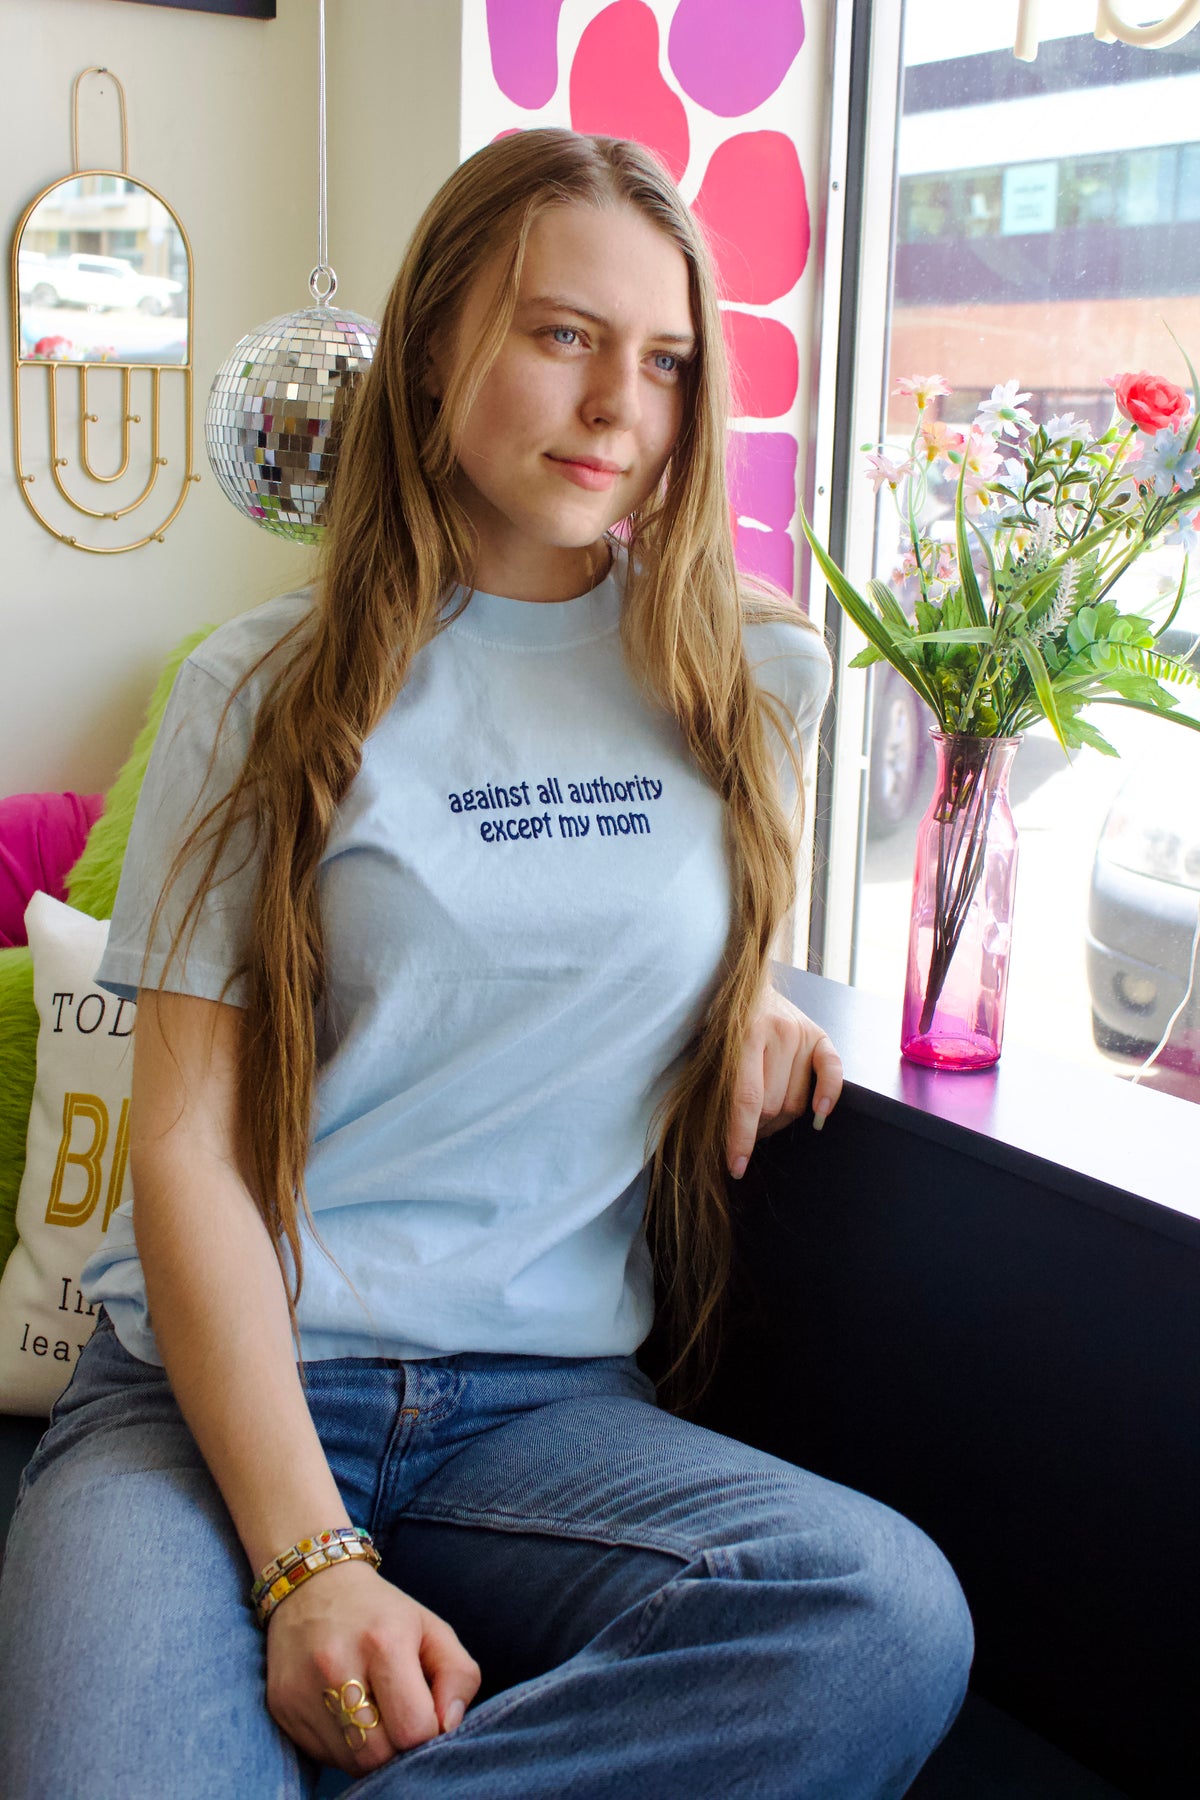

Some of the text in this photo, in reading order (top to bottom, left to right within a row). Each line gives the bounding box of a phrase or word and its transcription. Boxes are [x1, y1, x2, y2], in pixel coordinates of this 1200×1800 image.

[448, 775, 663, 813] against all authority
[480, 812, 651, 843] except my mom
[52, 992, 137, 1037] TOD
